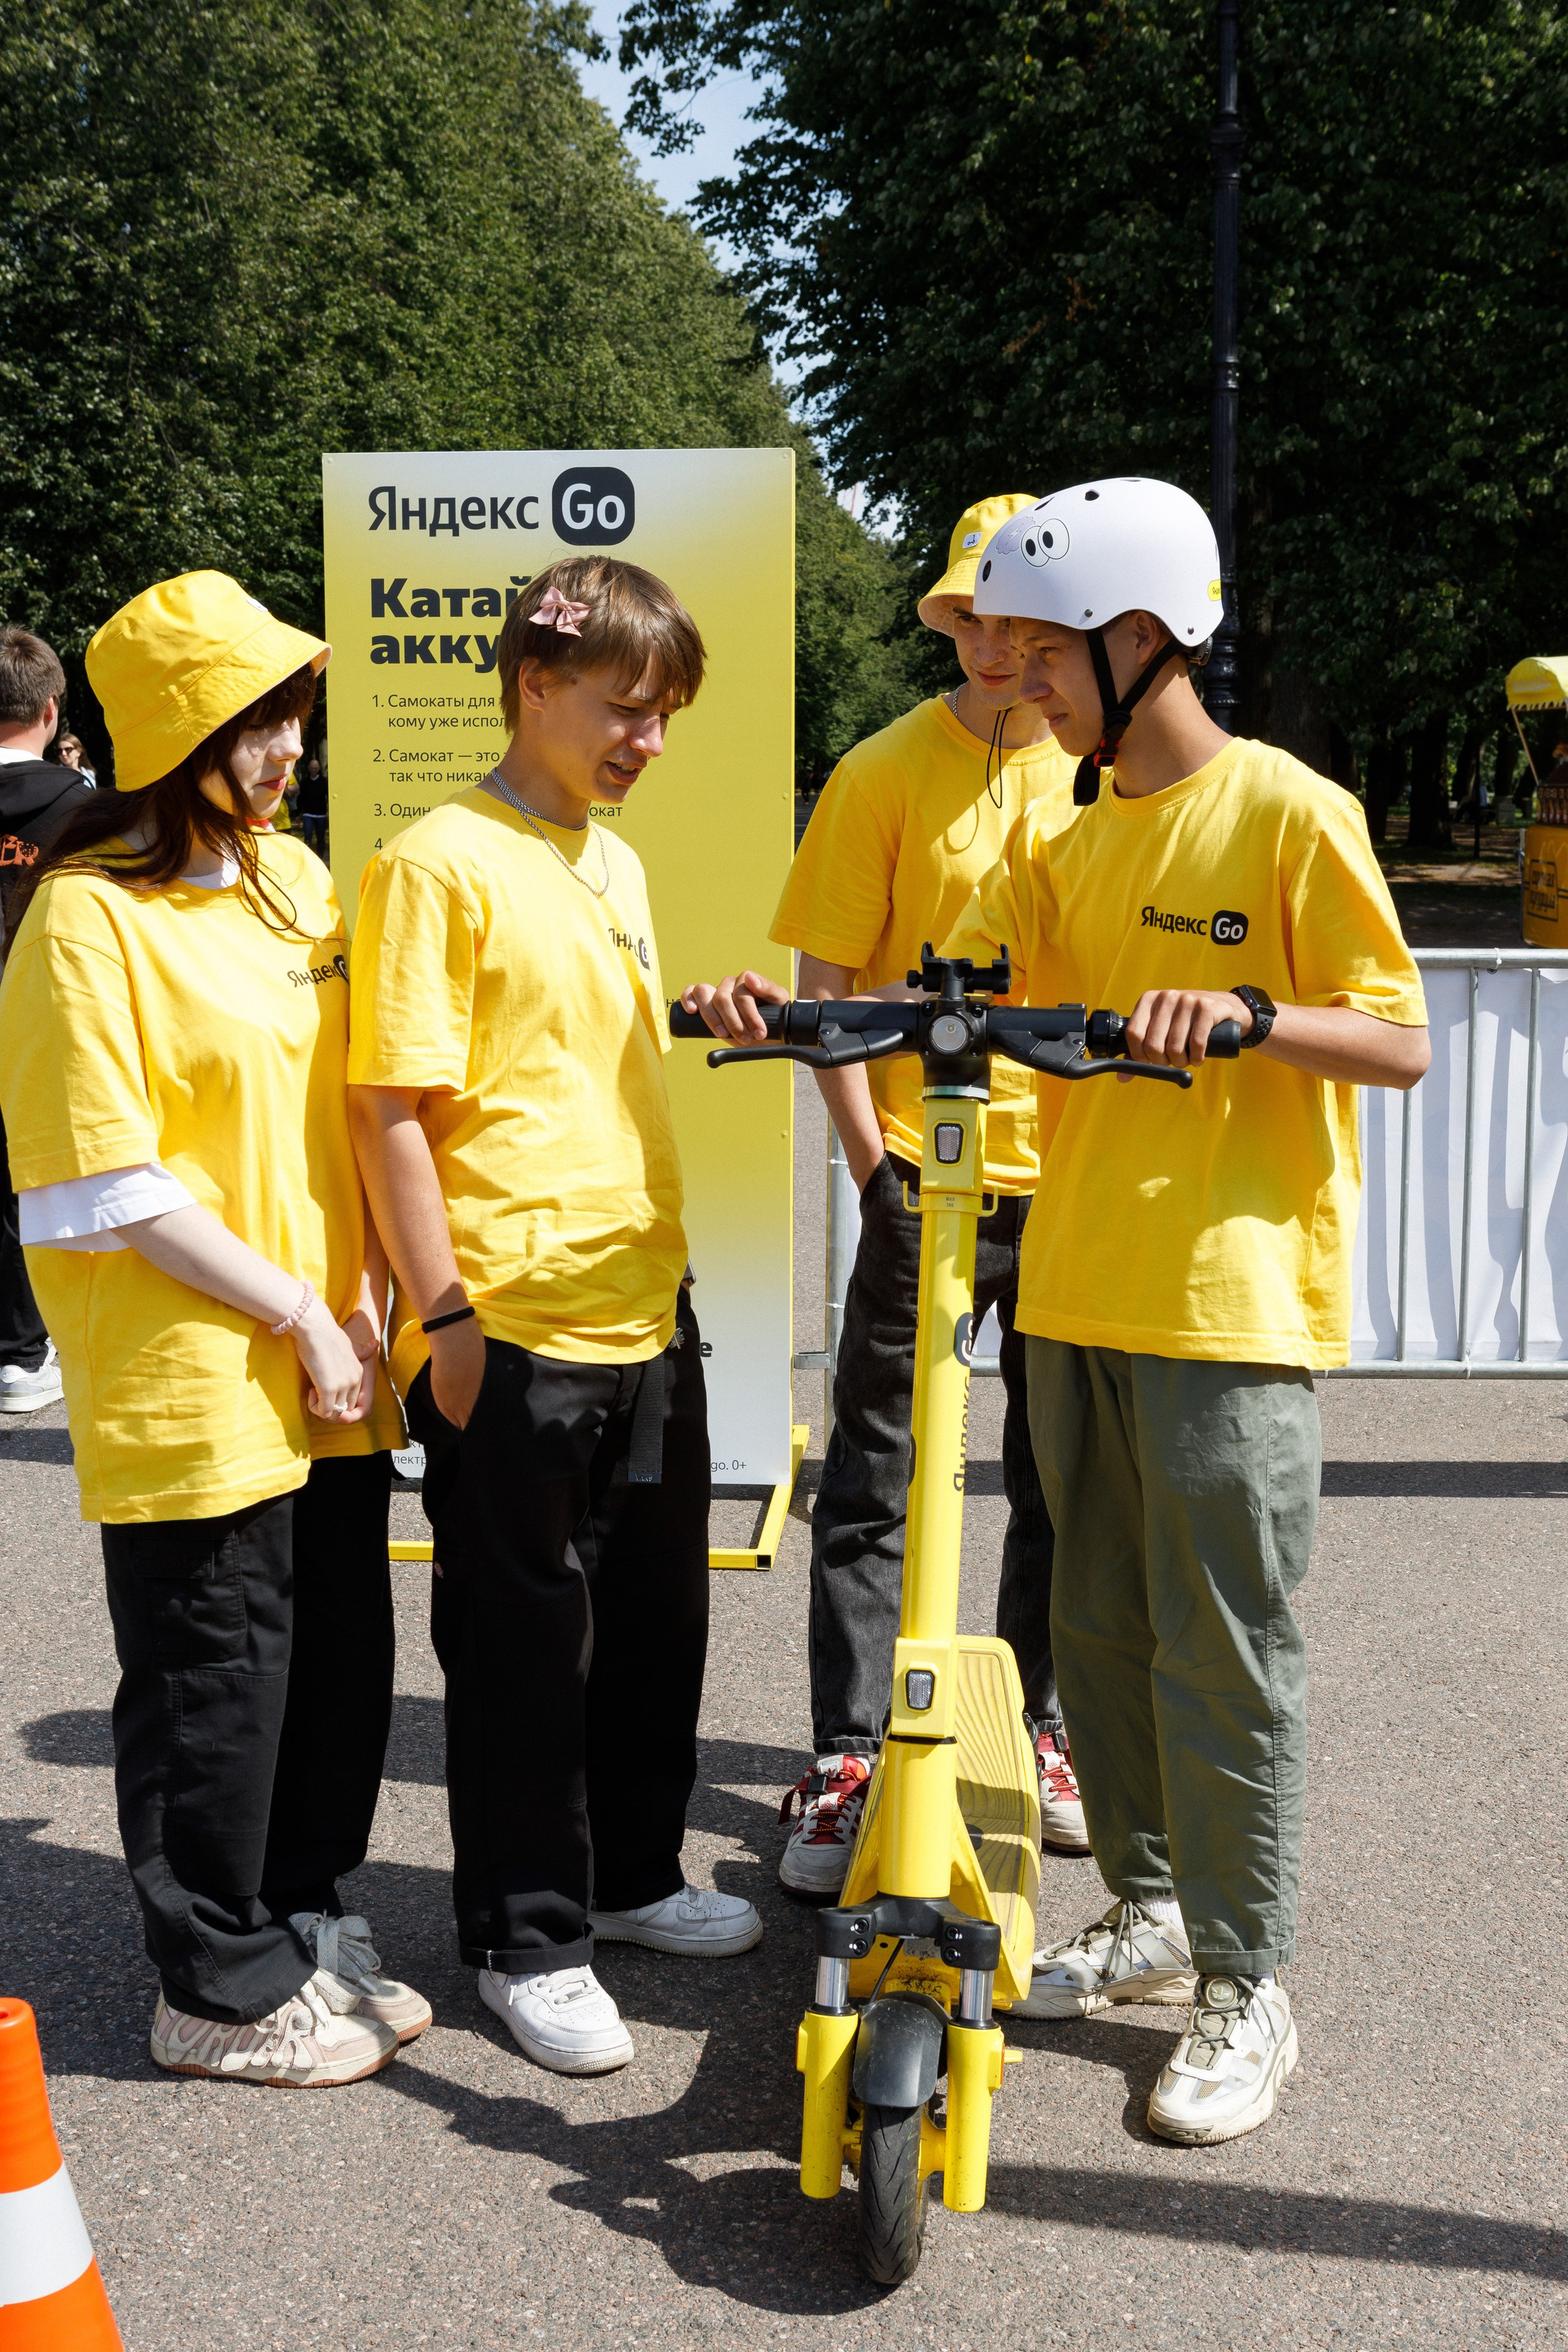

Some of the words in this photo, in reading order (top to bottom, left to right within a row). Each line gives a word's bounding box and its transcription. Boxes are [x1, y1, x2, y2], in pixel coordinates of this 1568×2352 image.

[369, 486, 539, 537] Яндекс
[562, 483, 625, 530] Go
[372, 695, 384, 707] 1.
[388, 695, 464, 707] Самокаты
[468, 697, 494, 709] для
[389, 717, 426, 729] кому
[429, 717, 459, 729] уже
[373, 749, 385, 762] 2.
[389, 749, 454, 762] Самокат
[476, 752, 500, 762] это
[390, 772, 413, 782] так
[417, 772, 442, 782] что
[374, 804, 386, 816] 3.
[390, 804, 431, 818] Один
[1140, 906, 1207, 935] Яндекс
[1215, 918, 1243, 939] Go
[732, 1460, 747, 1470] 0+
